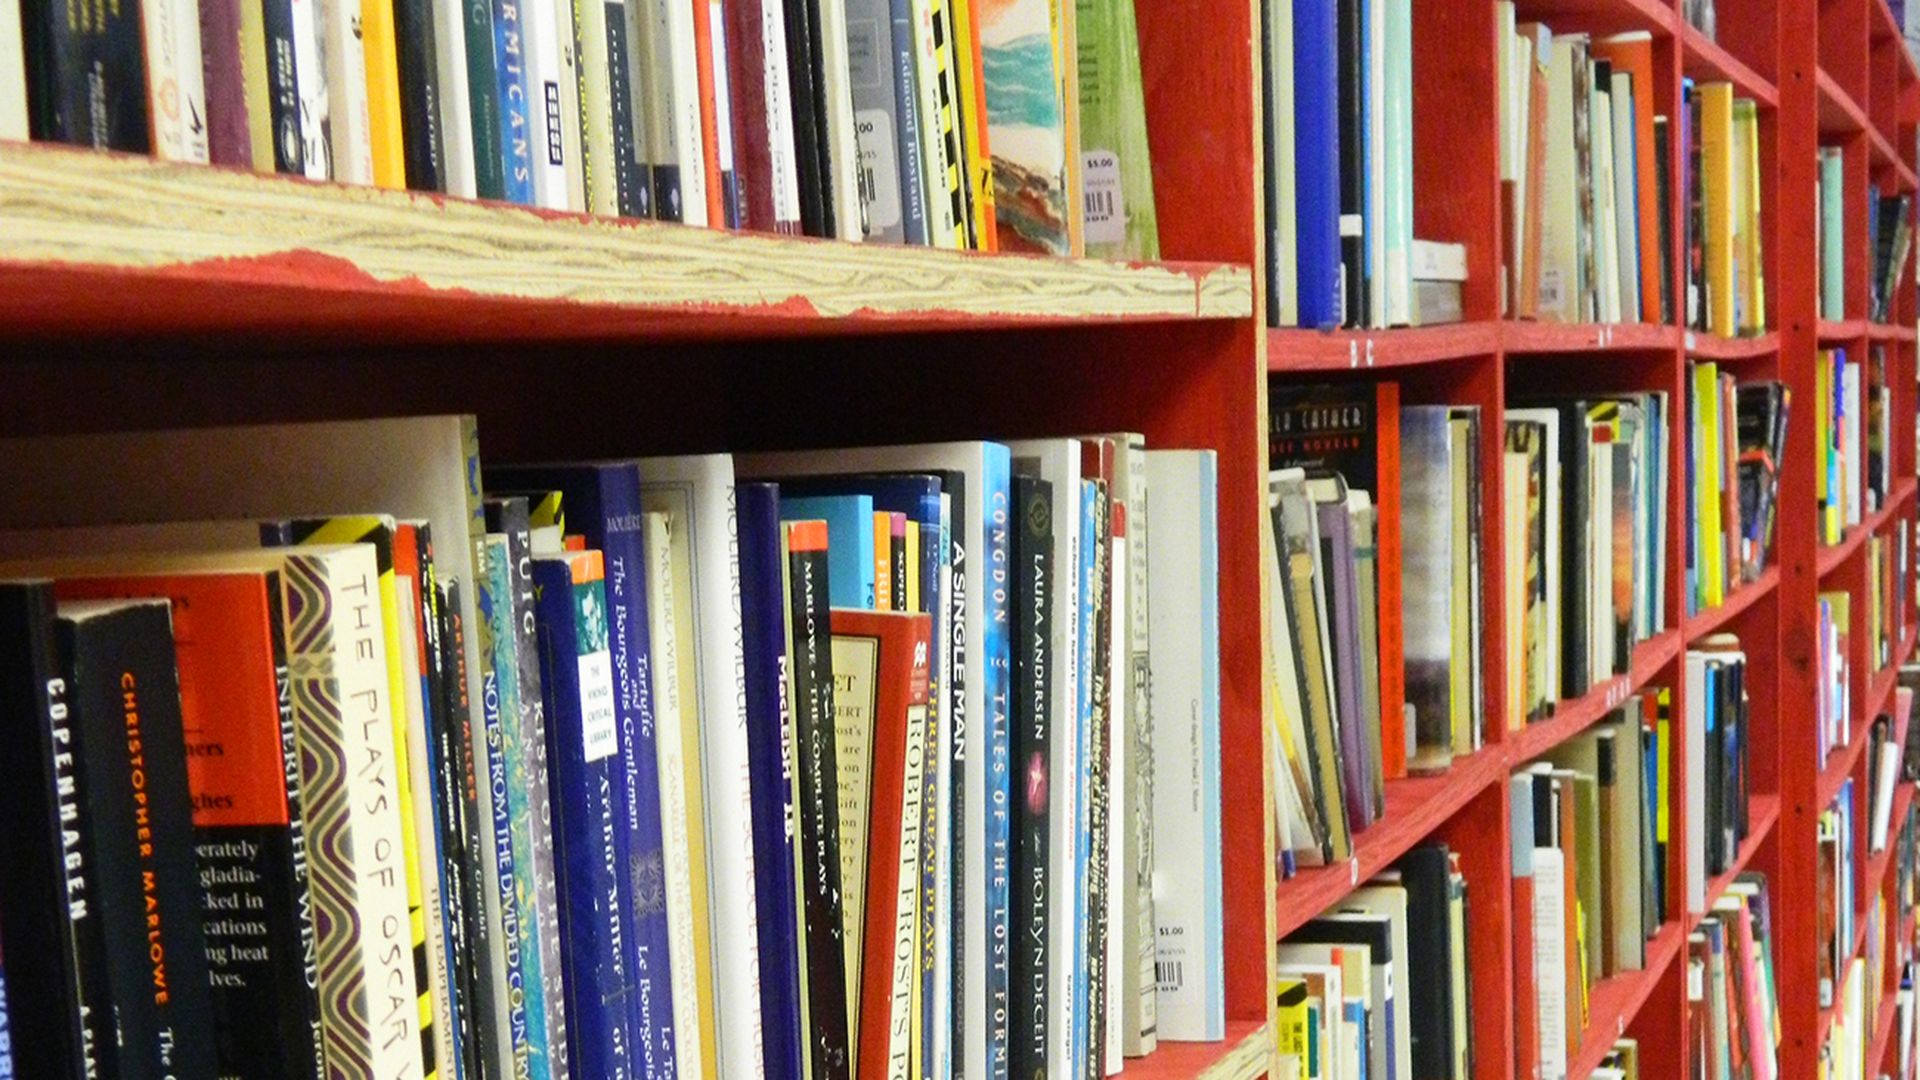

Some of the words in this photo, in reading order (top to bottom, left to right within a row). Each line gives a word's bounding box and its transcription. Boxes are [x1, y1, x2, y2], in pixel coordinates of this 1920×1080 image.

[425, 84, 438, 168] OXFORD
[901, 51, 914, 133] Edmond
[932, 88, 947, 190] PANTHEON
[907, 140, 921, 221] Rostand
[475, 541, 487, 574] KIM
[516, 529, 537, 636] PUIG
[612, 556, 626, 597] The
[952, 540, 966, 566] A
[991, 491, 1007, 623] CONGDON
[1033, 553, 1045, 627] LAURA
[340, 573, 374, 663] THE
[803, 561, 817, 666] MARLOWE
[953, 567, 967, 685] SINGLE
[615, 604, 632, 711] Bourgeois
[631, 679, 643, 709] and
[637, 654, 654, 738] Tartuffe
[1033, 632, 1045, 741] ANDERSEN
[1094, 674, 1104, 702] The
[453, 613, 469, 708] ARTHUR
[462, 719, 478, 801] MILLER
[484, 671, 503, 747] NOTES
[532, 700, 551, 787] KISS
[777, 655, 792, 780] MacLEISH
[809, 684, 820, 726] THE
[928, 677, 938, 774] THREE
[952, 689, 966, 761] MAN
[992, 693, 1007, 773] TALES
[1093, 706, 1103, 771] Member
[350, 688, 388, 816] PLAYS
[441, 732, 450, 759] THE
[623, 716, 639, 831] Gentleman
[811, 729, 826, 836] COMPLETE
[1093, 775, 1102, 791] of
[47, 677, 88, 922] COPENHAGEN
[489, 750, 508, 824] FROM
[540, 800, 554, 852] OF
[903, 717, 923, 866] ROBERT
[992, 789, 1006, 822] OF
[1092, 797, 1102, 824] the
[120, 671, 153, 858] CHRISTOPHER
[141, 870, 169, 1006] MARLOWE
[195, 839, 259, 862] erately
[290, 818, 308, 883] THE
[367, 837, 395, 889] OF
[471, 833, 479, 862] The
[495, 827, 512, 869] THE
[816, 840, 828, 897] PLAYS
[925, 784, 938, 876] GREAT
[954, 781, 965, 912] CHRISTOPHER
[993, 840, 1006, 888] THE
[1090, 827, 1102, 895] Wedding
[200, 866, 261, 888] gladia-
[202, 891, 240, 910] ked
[244, 892, 265, 909] in
[430, 887, 442, 926] THE
[474, 869, 487, 940] Crucible
[230, 943, 270, 962] heat
[297, 890, 319, 990] WIND
[499, 872, 521, 967] DIVIDED
[925, 887, 936, 970] PLAYS
[993, 908, 1006, 971] LOST
[1029, 866, 1044, 967] BOLEYN
[378, 914, 409, 1052] OSCAR
[637, 945, 648, 971] Le
[893, 887, 914, 1036] FROST'S
[954, 917, 965, 1034] ISHERWOOD
[80, 1005, 91, 1017] A
[158, 1026, 174, 1067] The
[508, 972, 530, 1080] COUNTRY
[661, 1026, 671, 1053] Le
[1033, 973, 1045, 1056] DECEIT
